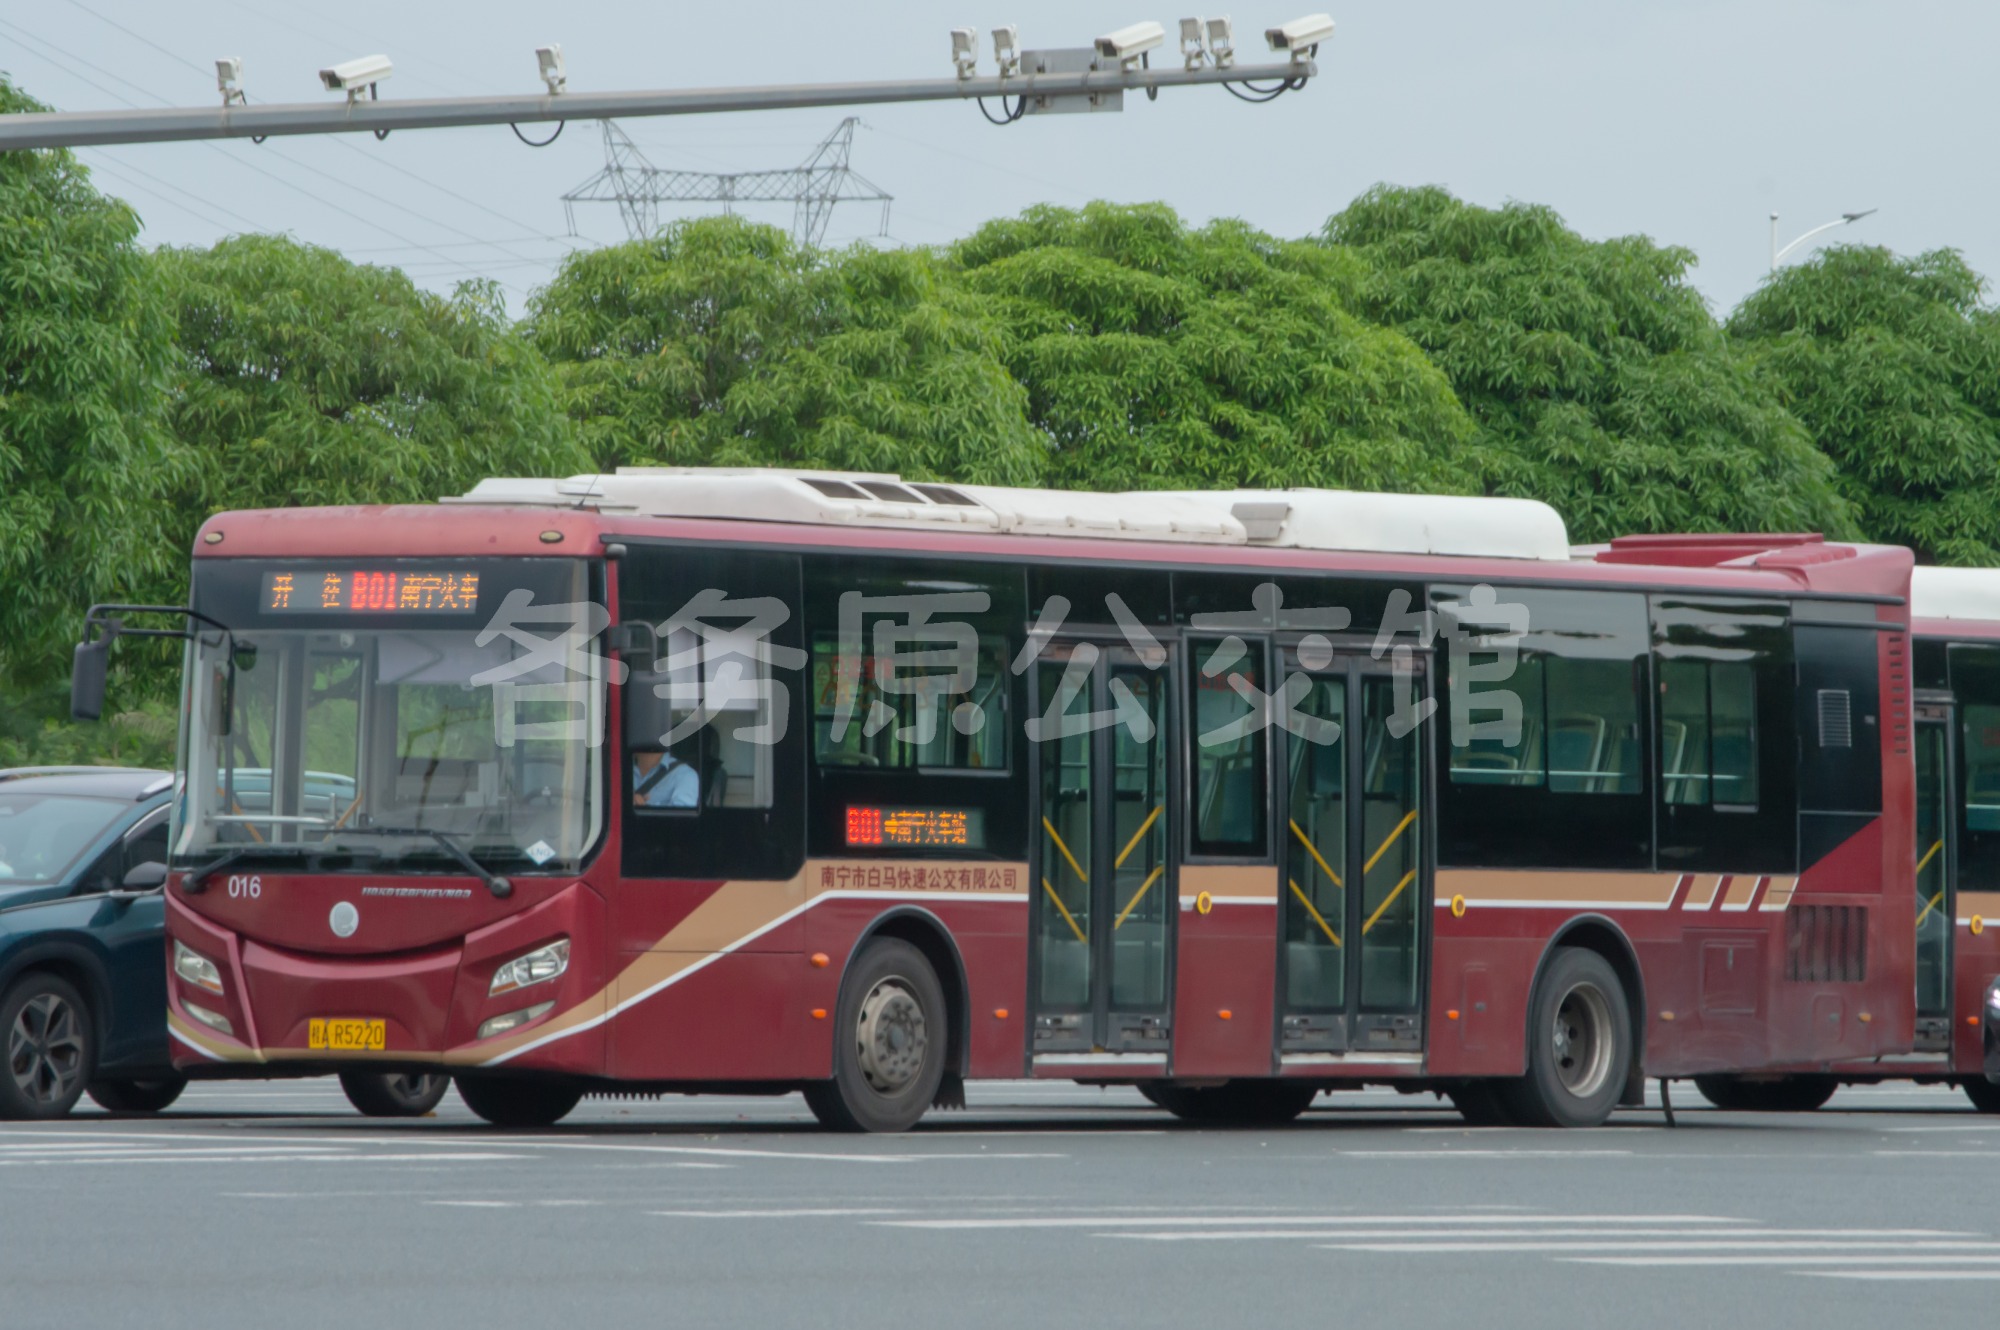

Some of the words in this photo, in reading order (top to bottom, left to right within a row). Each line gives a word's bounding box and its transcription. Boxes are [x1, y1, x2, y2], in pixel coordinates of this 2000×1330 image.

[228, 875, 261, 898] 016
[821, 865, 1017, 890] 南宁市白马快速公交有限公司
